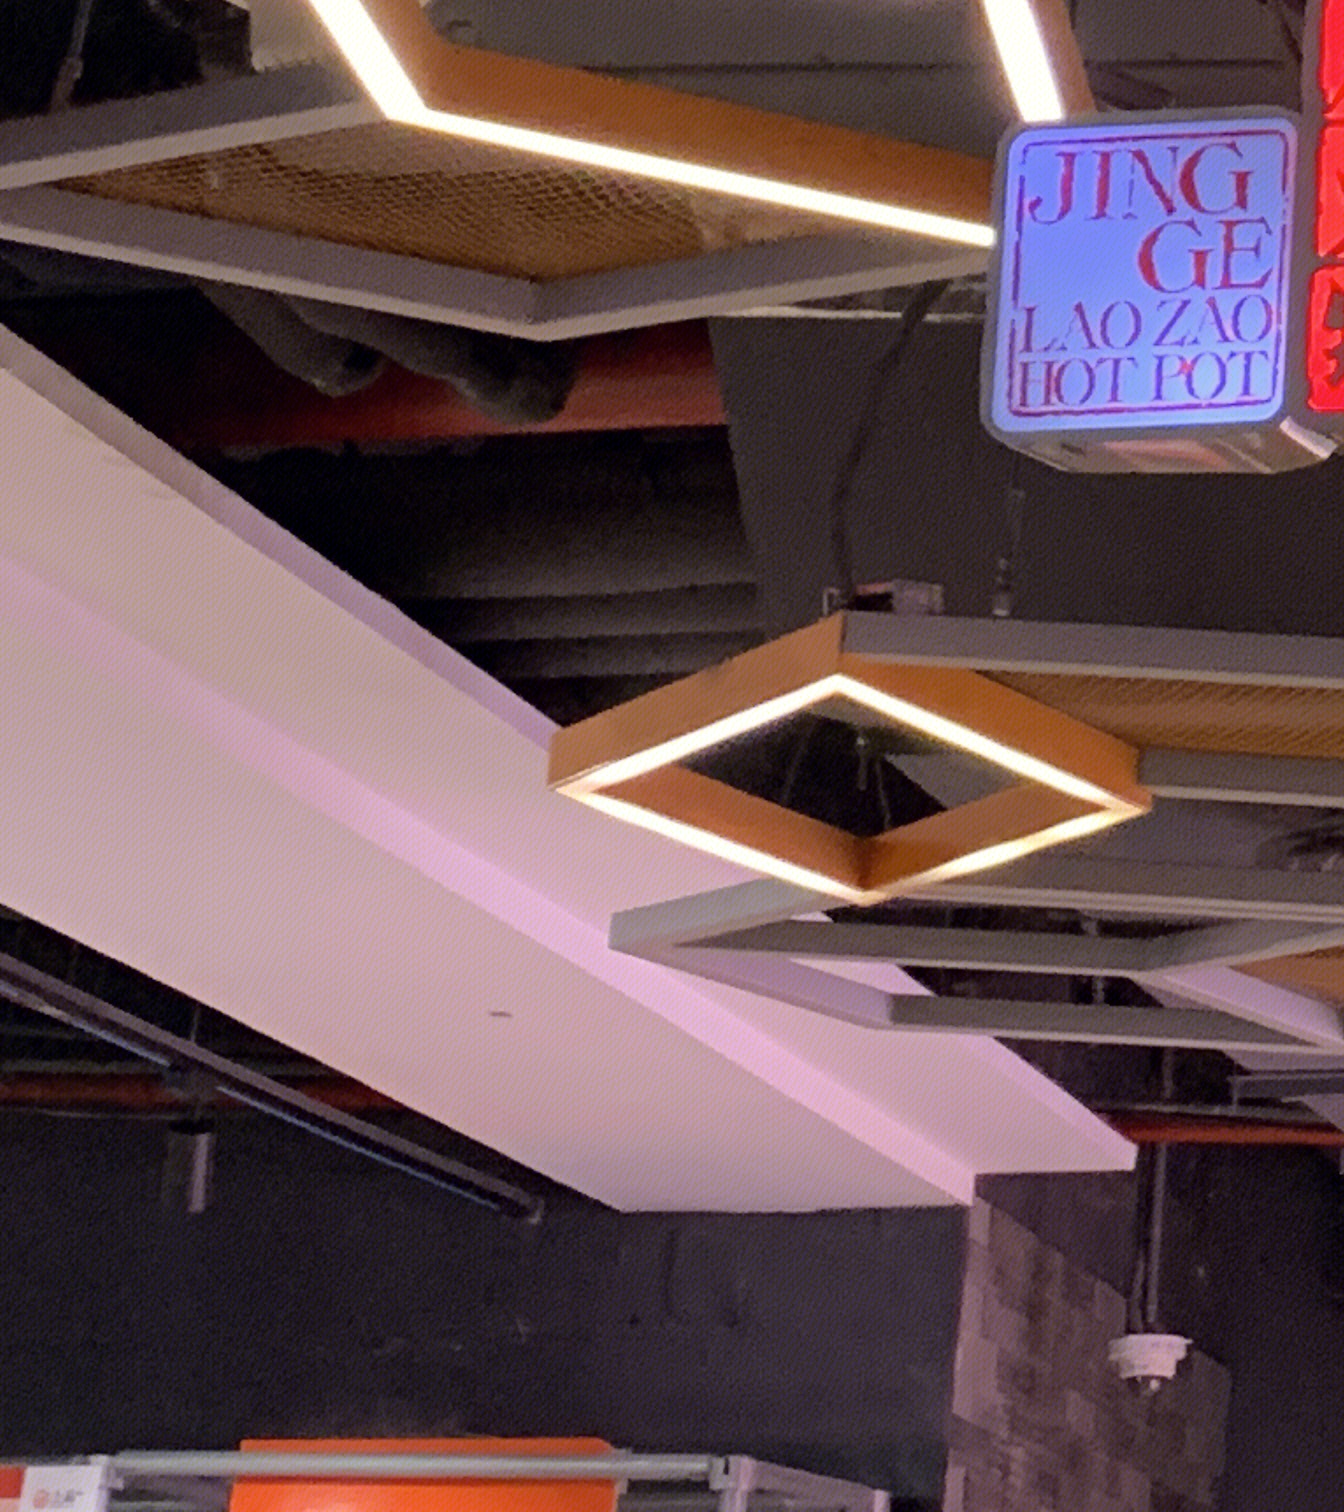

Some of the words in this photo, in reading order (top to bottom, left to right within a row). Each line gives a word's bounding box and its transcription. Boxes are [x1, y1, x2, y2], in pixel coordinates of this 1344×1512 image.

[1028, 140, 1254, 226] JING
[1137, 216, 1274, 294] GE
[1022, 300, 1142, 354] LAO
[1153, 294, 1274, 348] ZAO
[1018, 355, 1139, 407] HOT
[1152, 349, 1270, 402] POT
